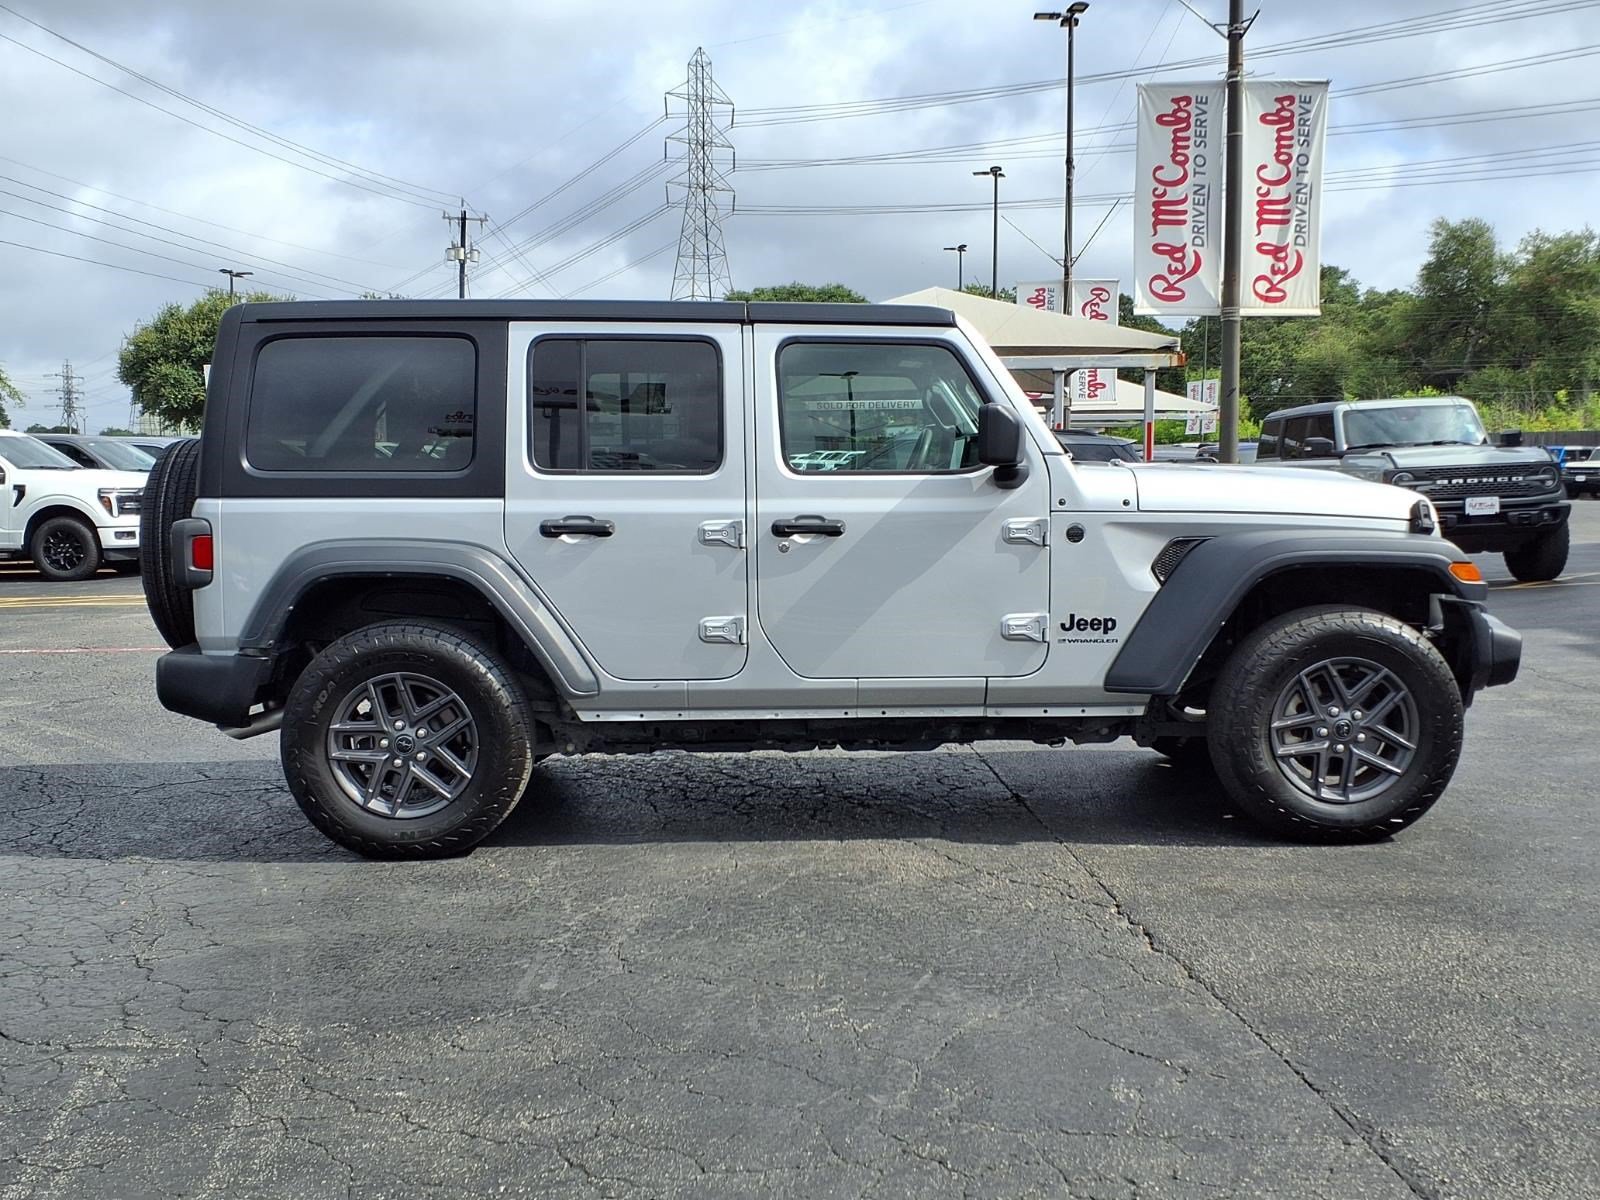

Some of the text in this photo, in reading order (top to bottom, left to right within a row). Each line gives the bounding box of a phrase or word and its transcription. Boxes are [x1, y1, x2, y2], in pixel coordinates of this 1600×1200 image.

[1192, 95, 1209, 248] DRIVEN TO SERVE
[1294, 94, 1312, 247] DRIVEN TO SERVE
[1149, 95, 1202, 302] Red McCombs
[1252, 94, 1304, 304] Red McCombs
[1047, 287, 1055, 311] ERVE
[1082, 287, 1110, 320] Red
[1078, 370, 1087, 399] SERVE
[816, 402, 843, 410] SOLD
[868, 401, 917, 409] DELIVERY
[1435, 476, 1524, 485] BRONCO
[1060, 613, 1117, 635] Jeep
